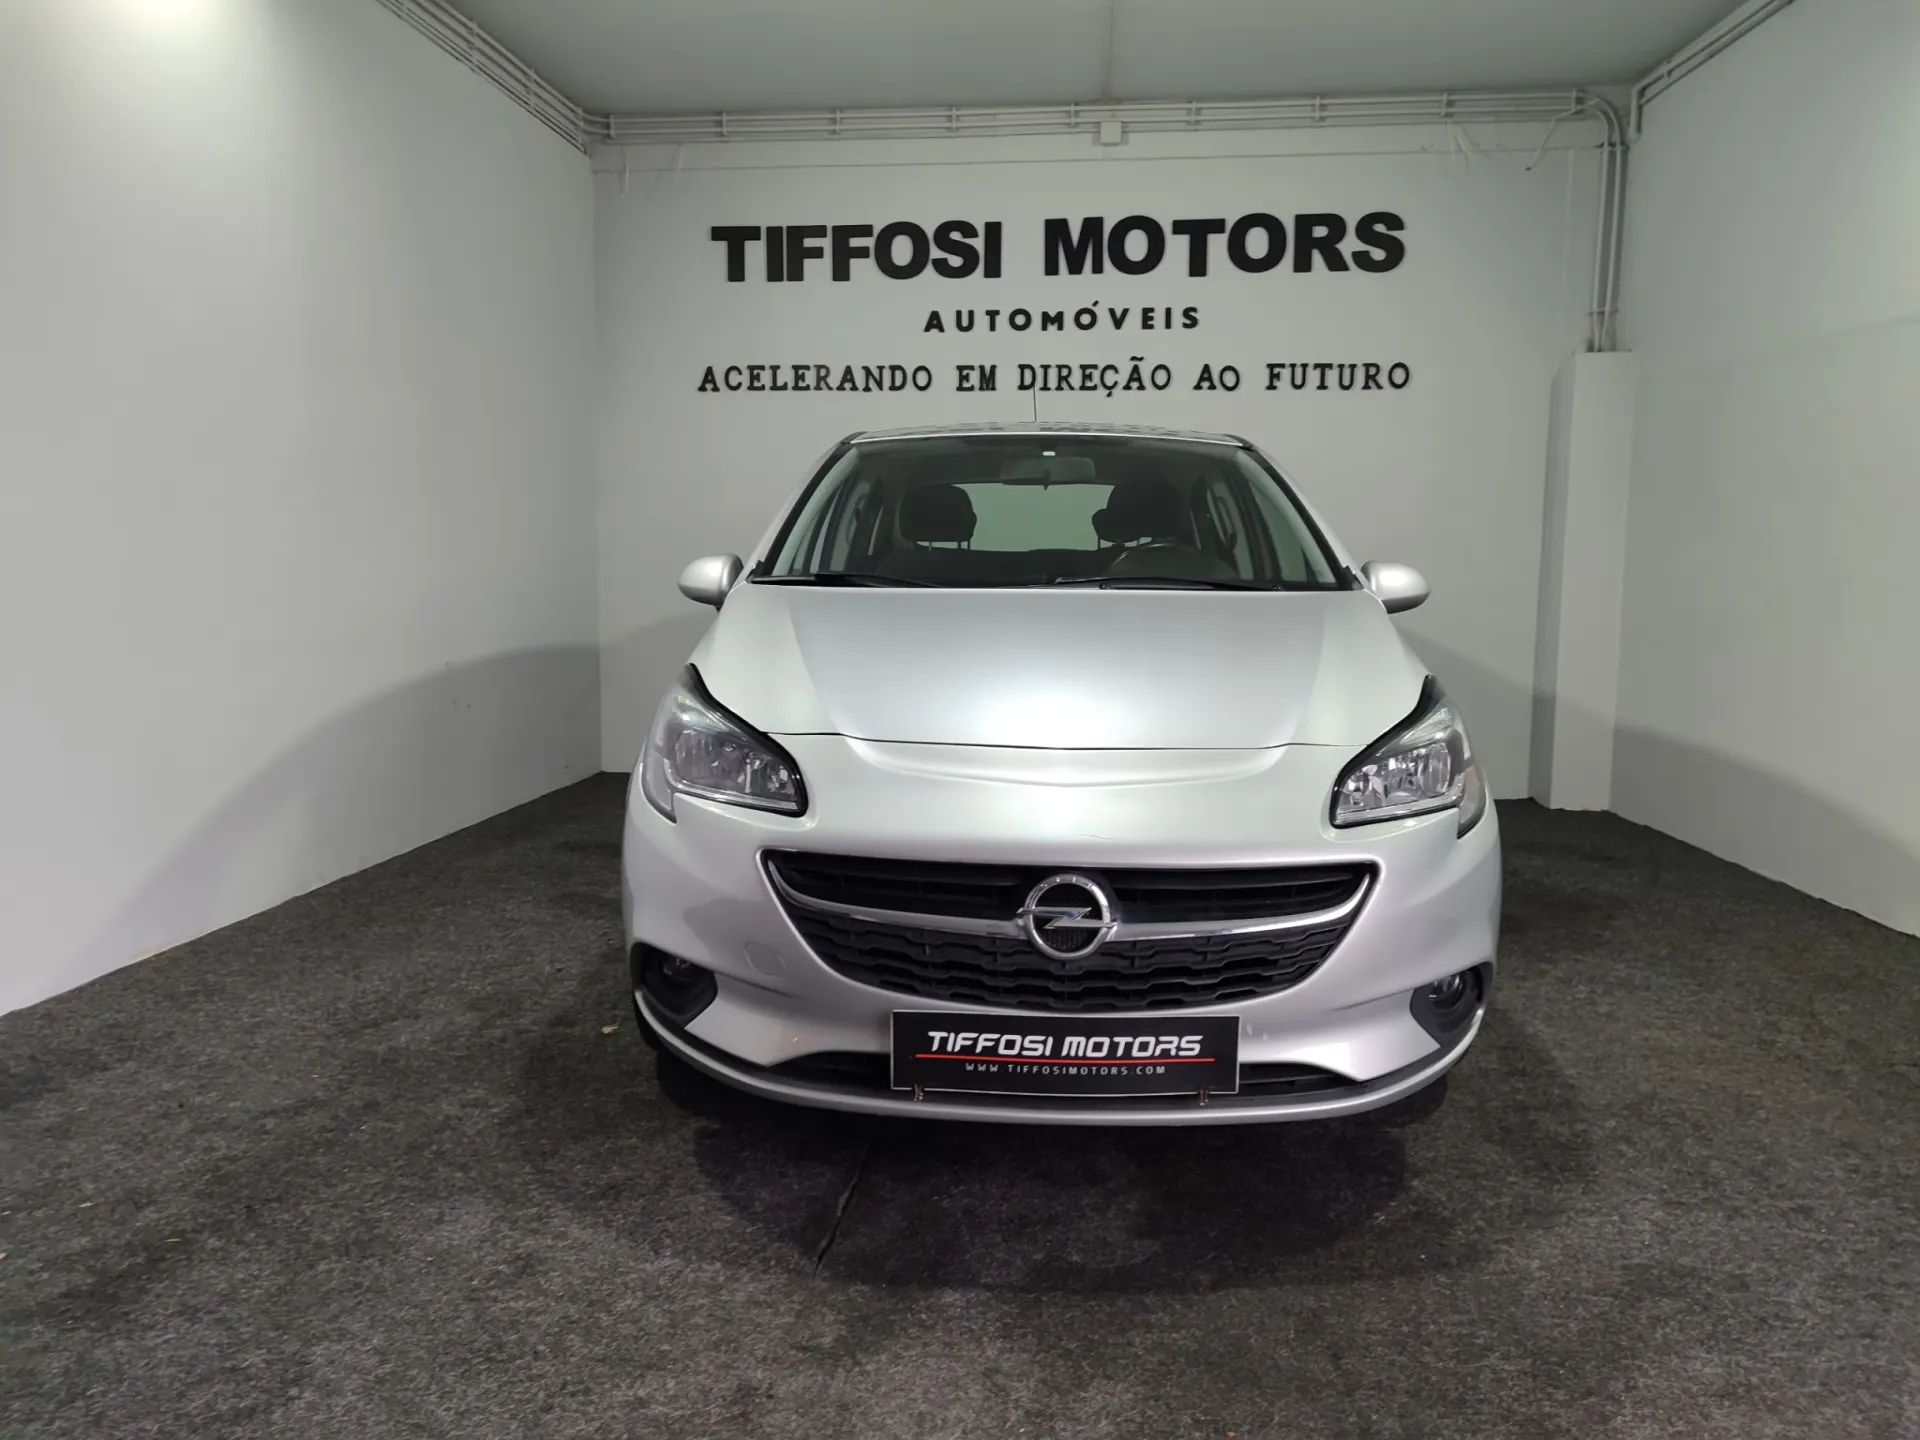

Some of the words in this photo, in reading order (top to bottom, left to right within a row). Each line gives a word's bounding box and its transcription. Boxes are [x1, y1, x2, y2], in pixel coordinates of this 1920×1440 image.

[711, 220, 1003, 283] TIFFOSI
[1044, 211, 1406, 278] MOTORS
[923, 300, 1199, 333] AUTOMÓVEIS
[698, 364, 933, 393] ACELERANDO
[956, 364, 998, 392] EM
[1017, 356, 1172, 398] DIREÇÃO
[1193, 364, 1241, 392] AO
[1265, 361, 1411, 391] FUTURO
[927, 1031, 1054, 1057] TIFFOSI
[1061, 1035, 1204, 1058] MOTORS
